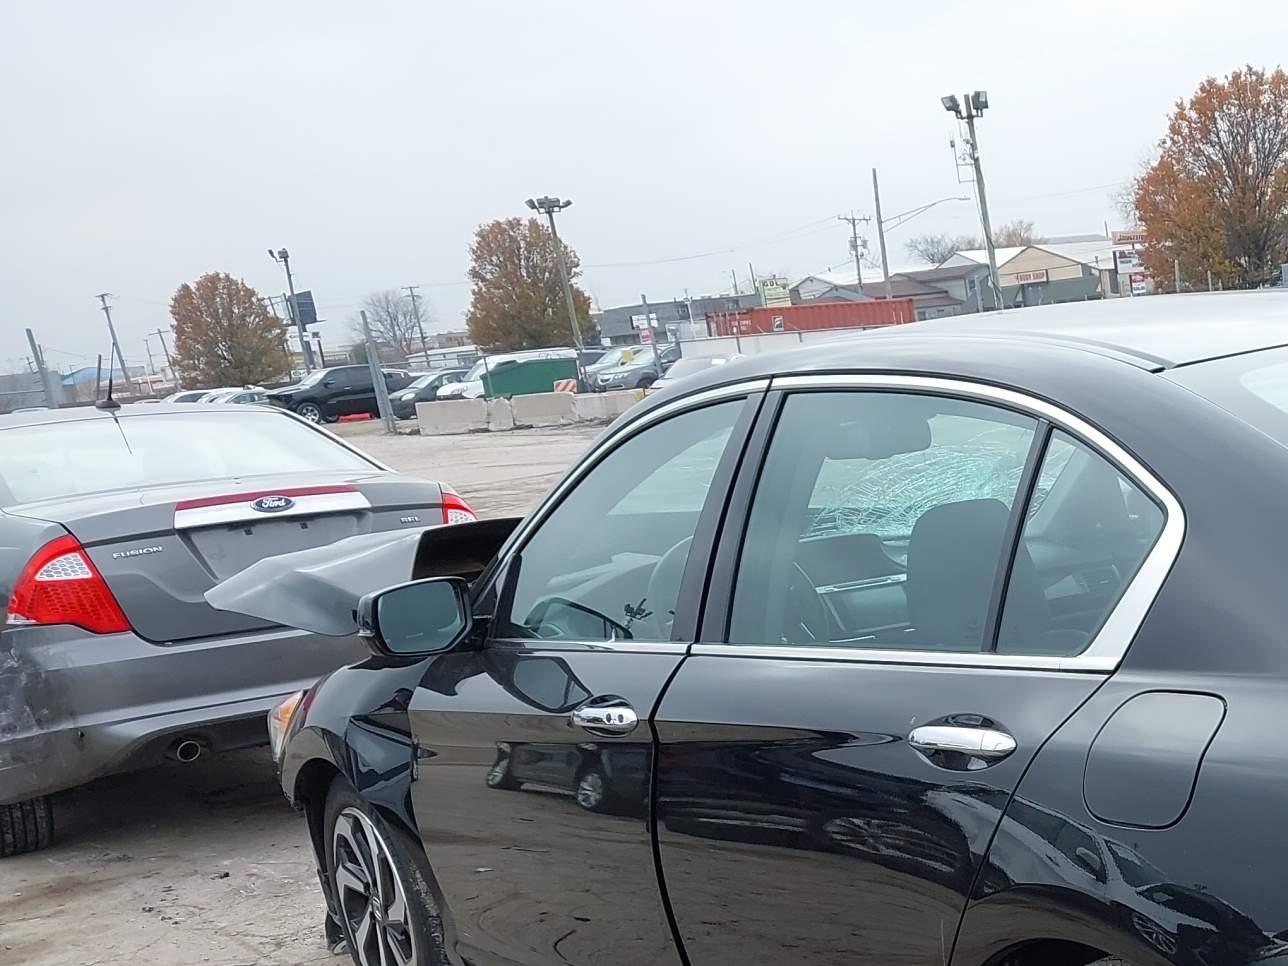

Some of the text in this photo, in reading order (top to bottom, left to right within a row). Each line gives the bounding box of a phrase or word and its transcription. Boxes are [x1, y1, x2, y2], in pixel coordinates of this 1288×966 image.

[1032, 271, 1045, 281] SHOP
[261, 497, 286, 508] Ford
[112, 545, 164, 559] FUSION
